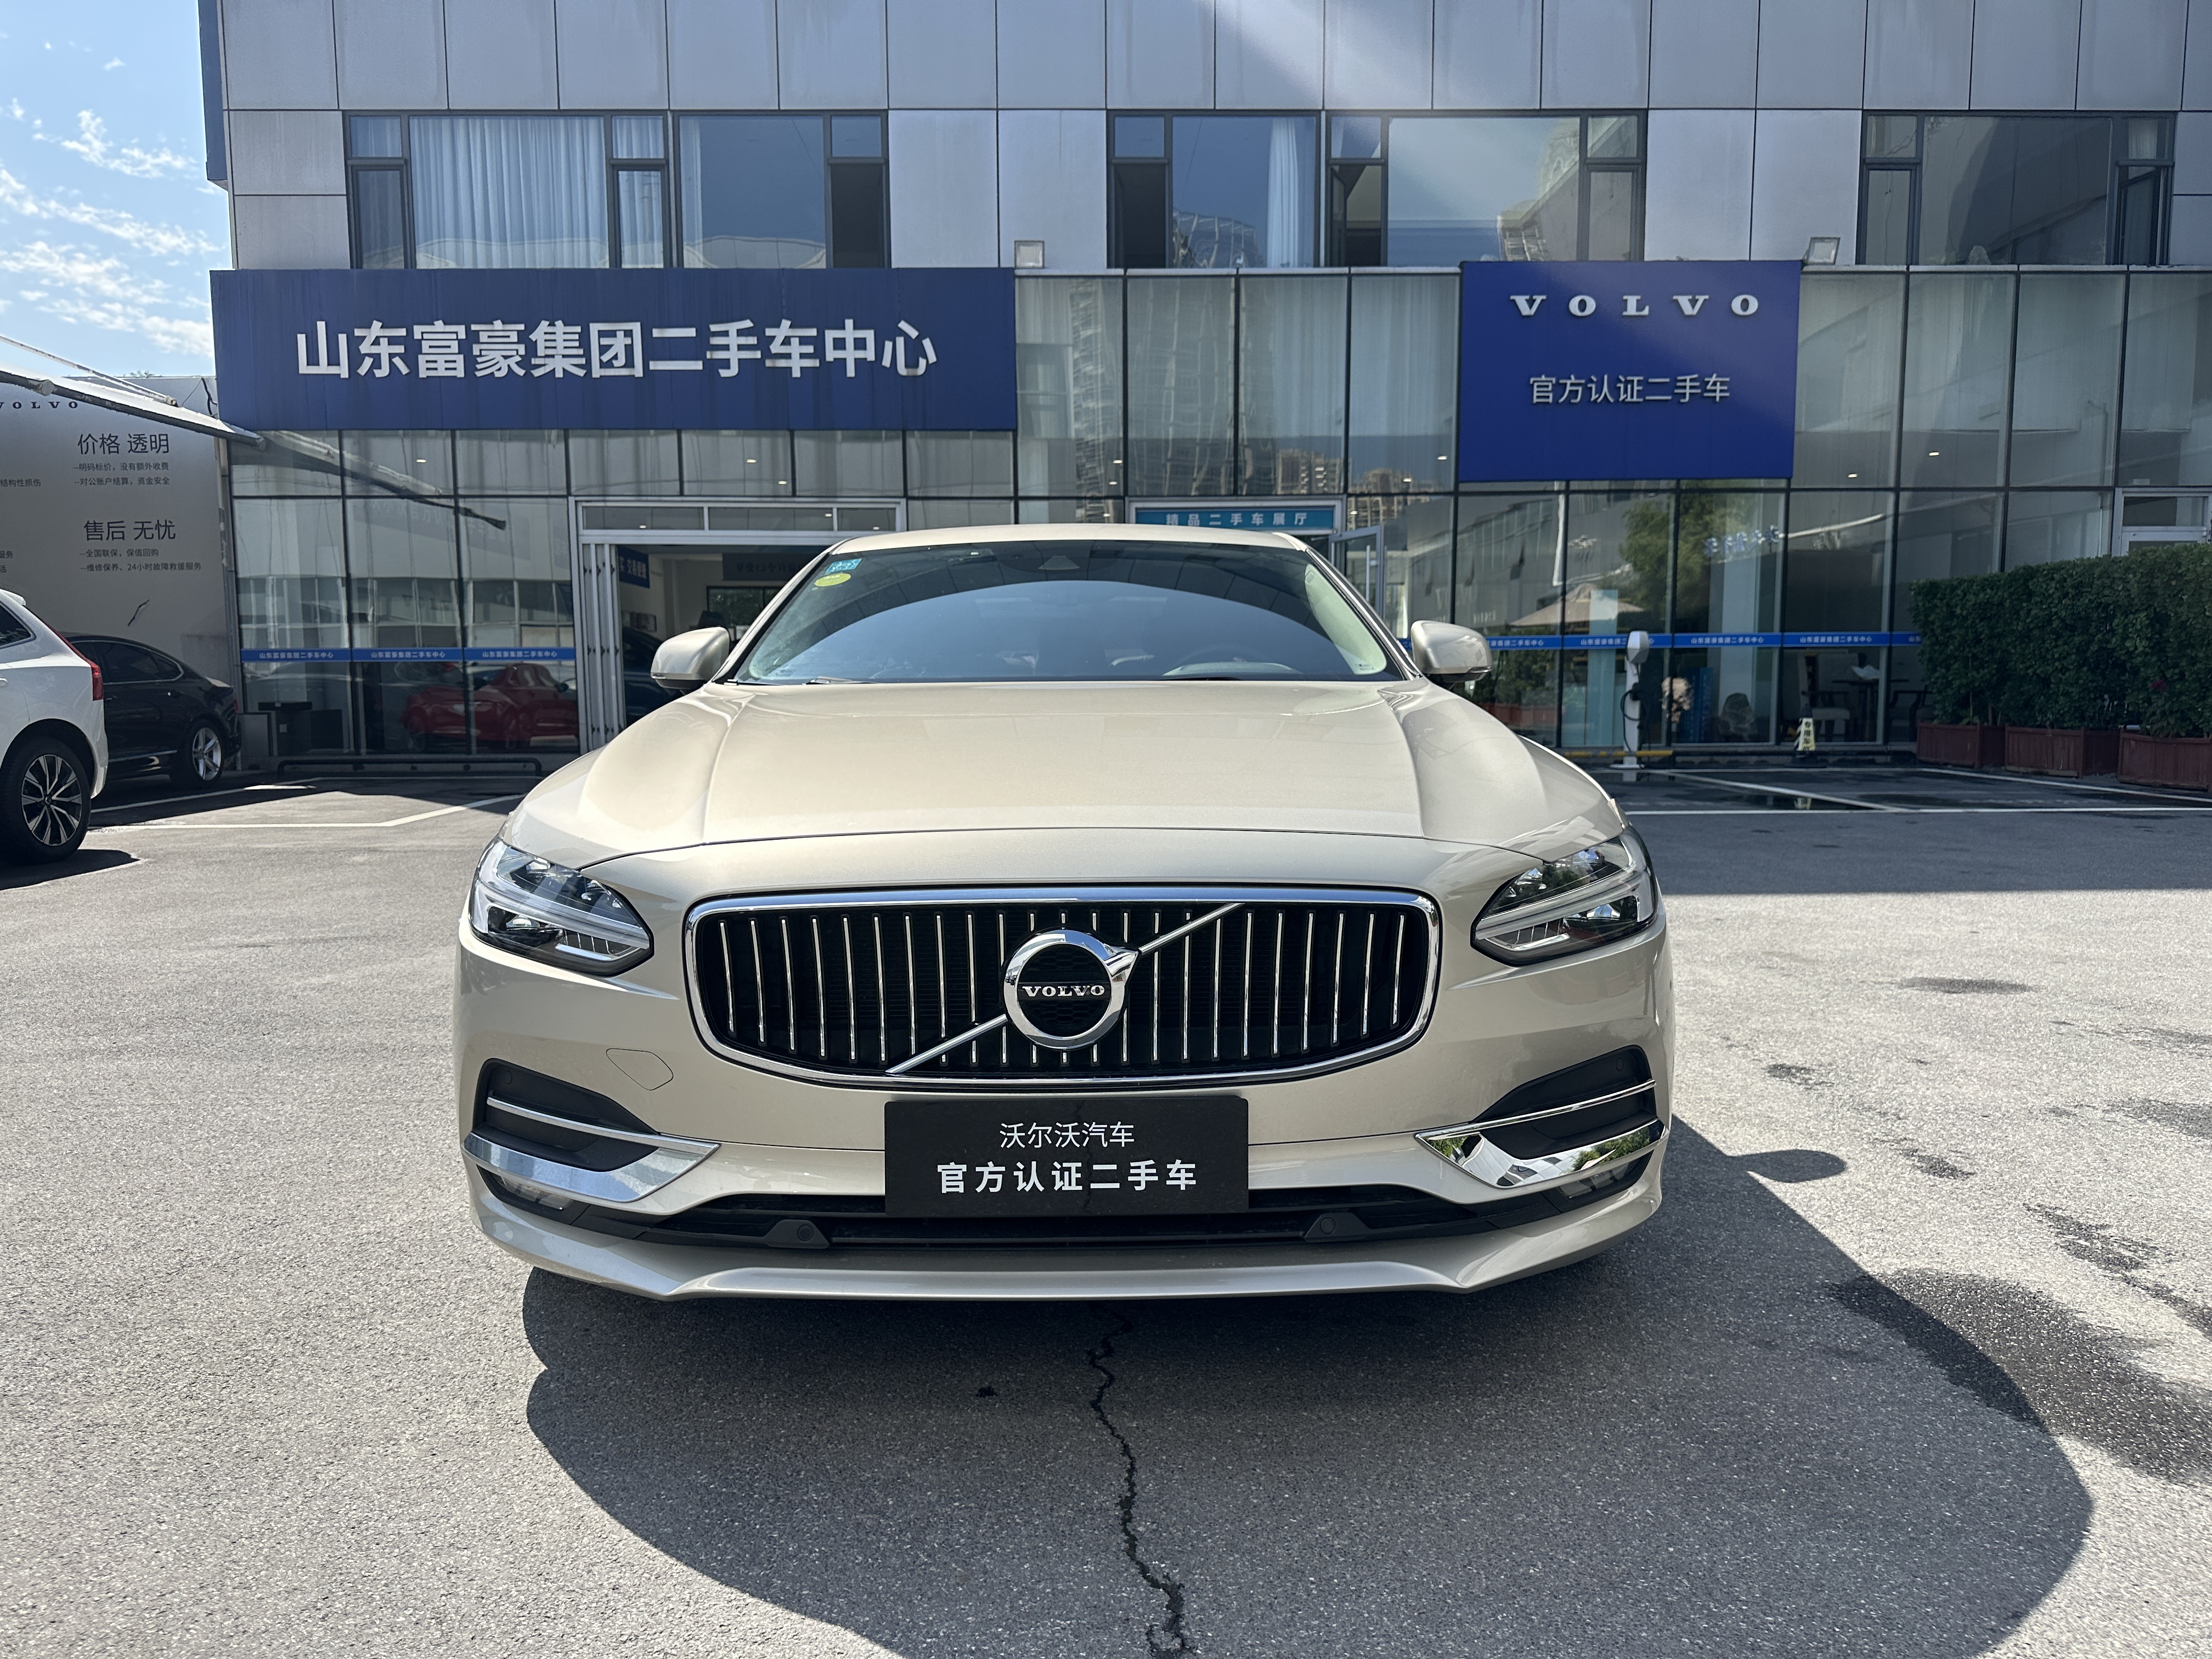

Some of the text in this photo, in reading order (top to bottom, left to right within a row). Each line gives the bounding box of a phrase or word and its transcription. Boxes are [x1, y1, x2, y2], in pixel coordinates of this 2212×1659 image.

[1510, 295, 1758, 317] VOLVO
[297, 319, 938, 379] 山东富豪集团二手车中心
[1530, 373, 1730, 403] 官方认证二手车
[78, 433, 170, 455] 价格 透明
[84, 520, 176, 541] 售后 无忧
[1166, 512, 1307, 527] 精品二手车展厅
[1022, 985, 1105, 997] VOLVO
[999, 1121, 1135, 1149] 沃尔沃汽车
[937, 1159, 1197, 1194] 官方认证二手车
